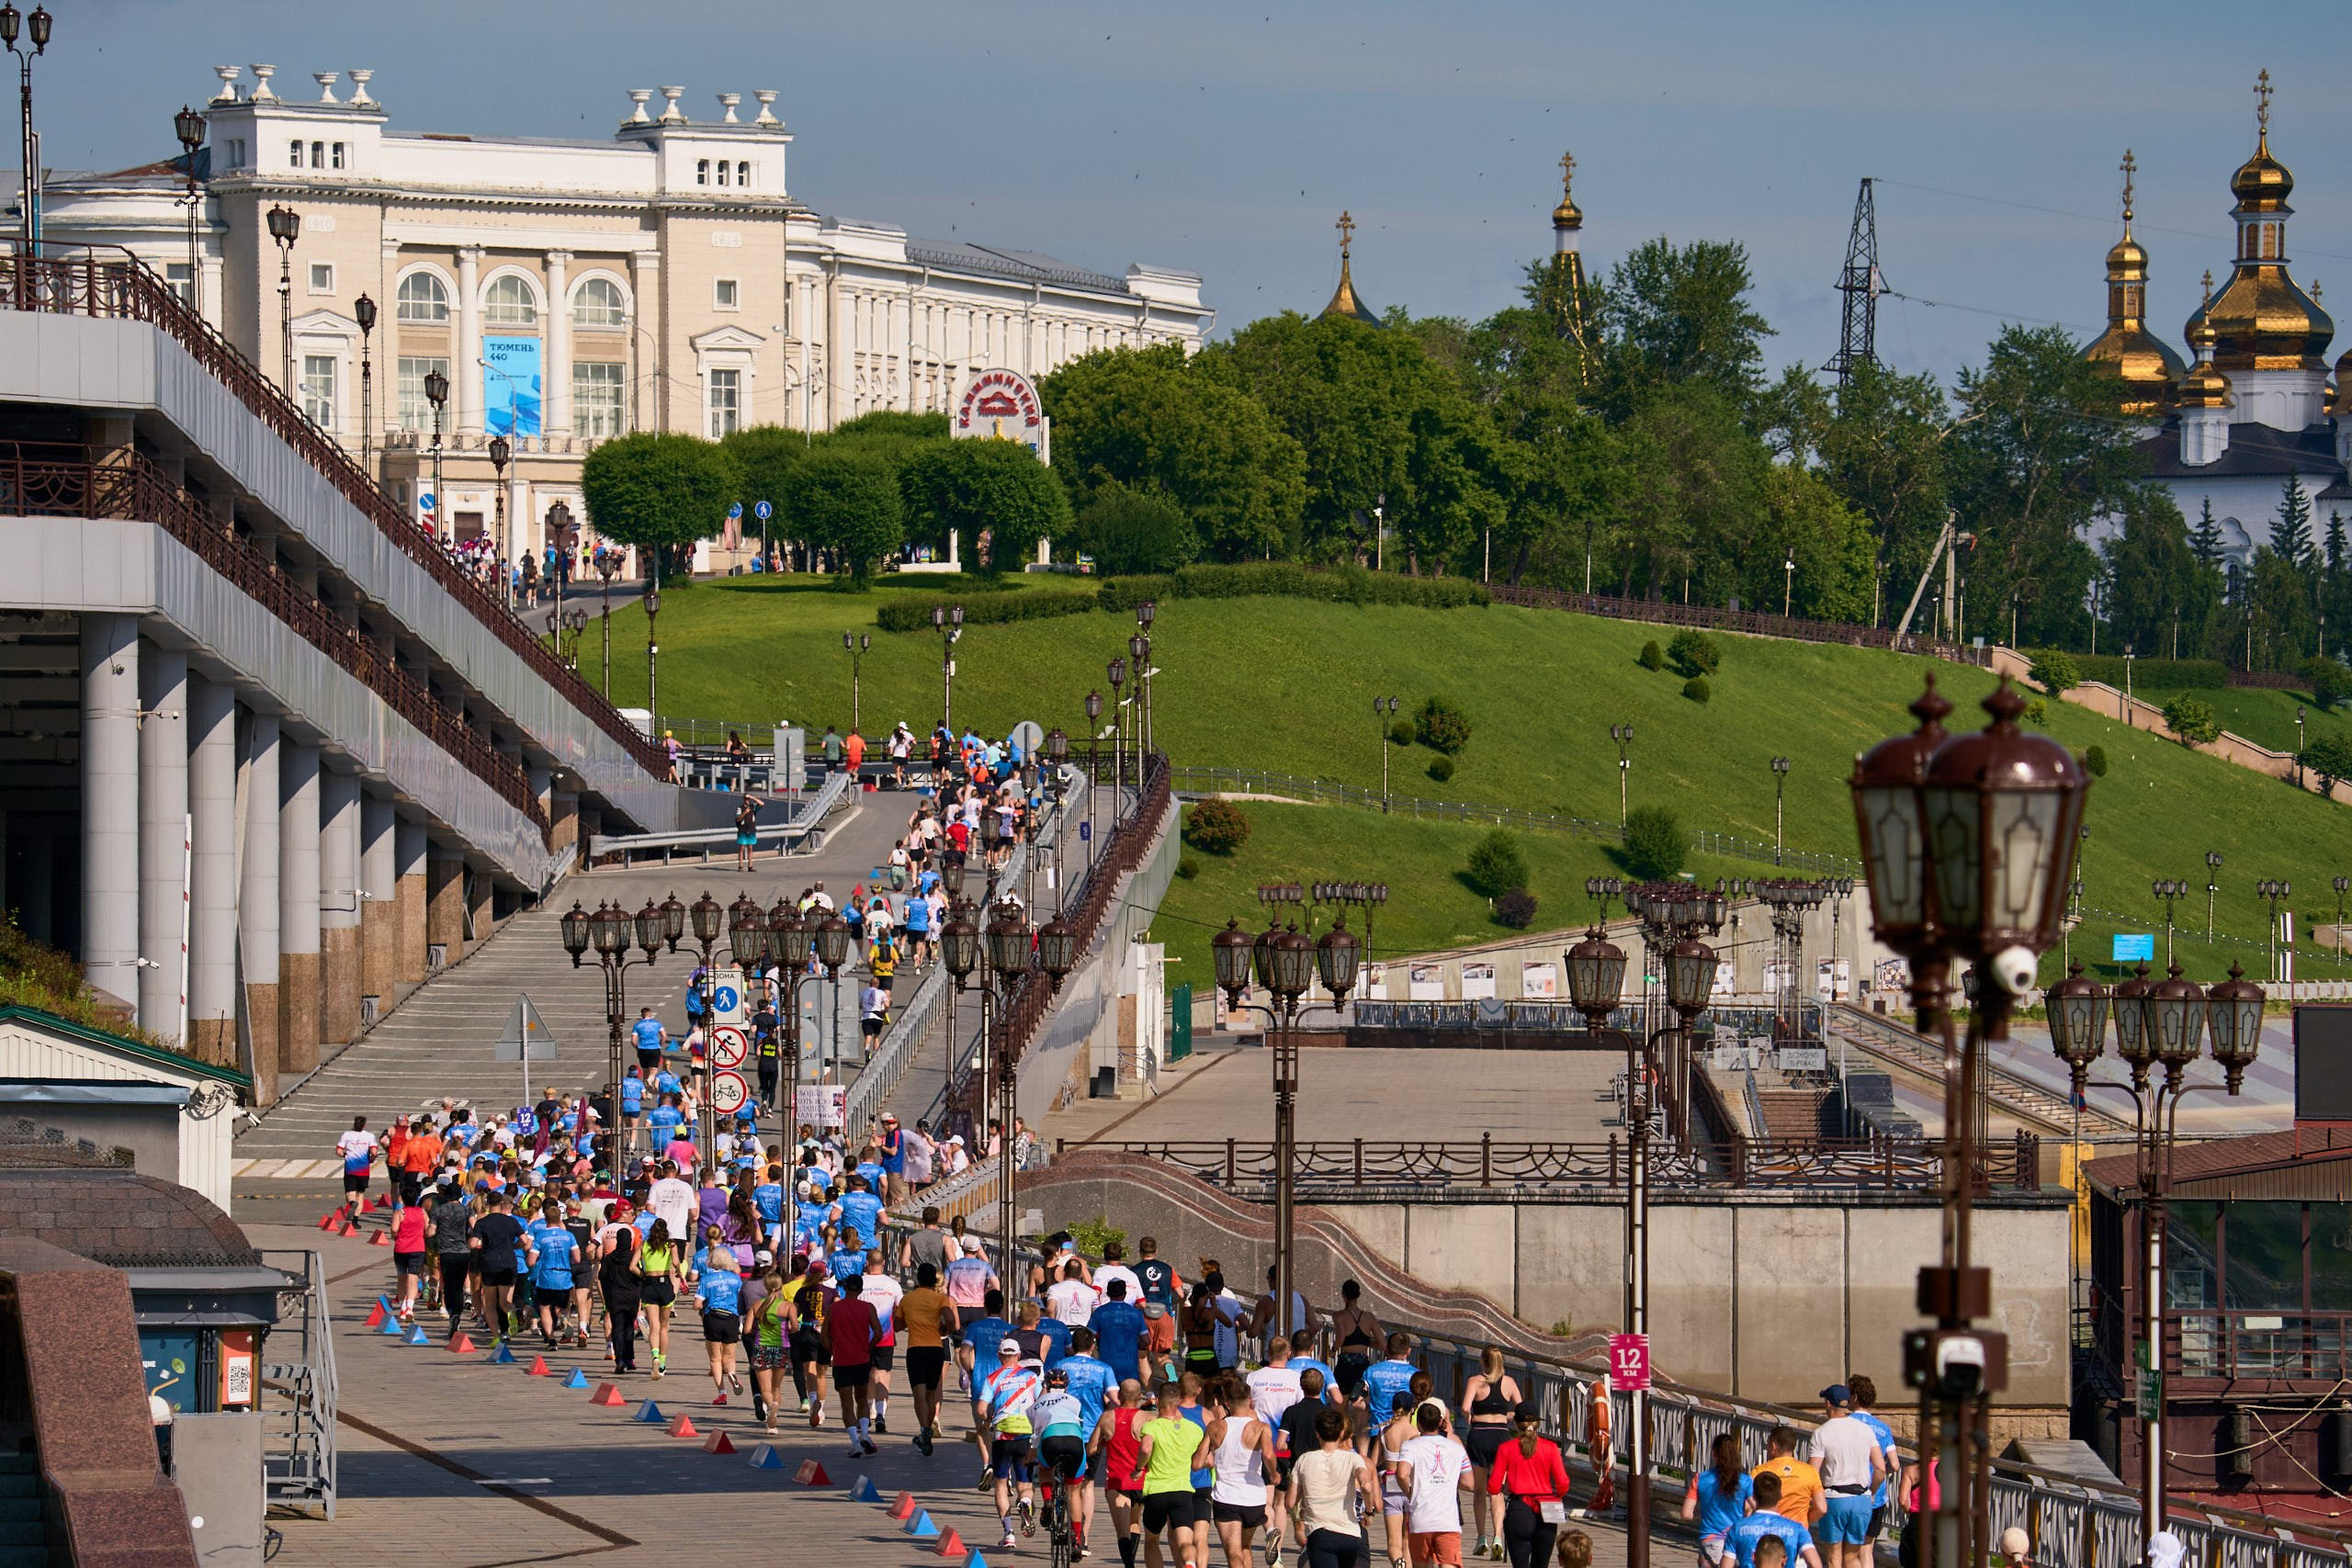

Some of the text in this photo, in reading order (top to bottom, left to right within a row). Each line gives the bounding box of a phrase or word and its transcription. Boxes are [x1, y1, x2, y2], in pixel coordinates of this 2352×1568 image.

[490, 344, 535, 352] ТЮМЕНЬ
[490, 353, 507, 361] 440
[520, 1113, 531, 1123] 12
[806, 1292, 823, 1301] LEG
[1617, 1348, 1642, 1369] 12
[1740, 1525, 1793, 1537] ТЮМЕНЬ
